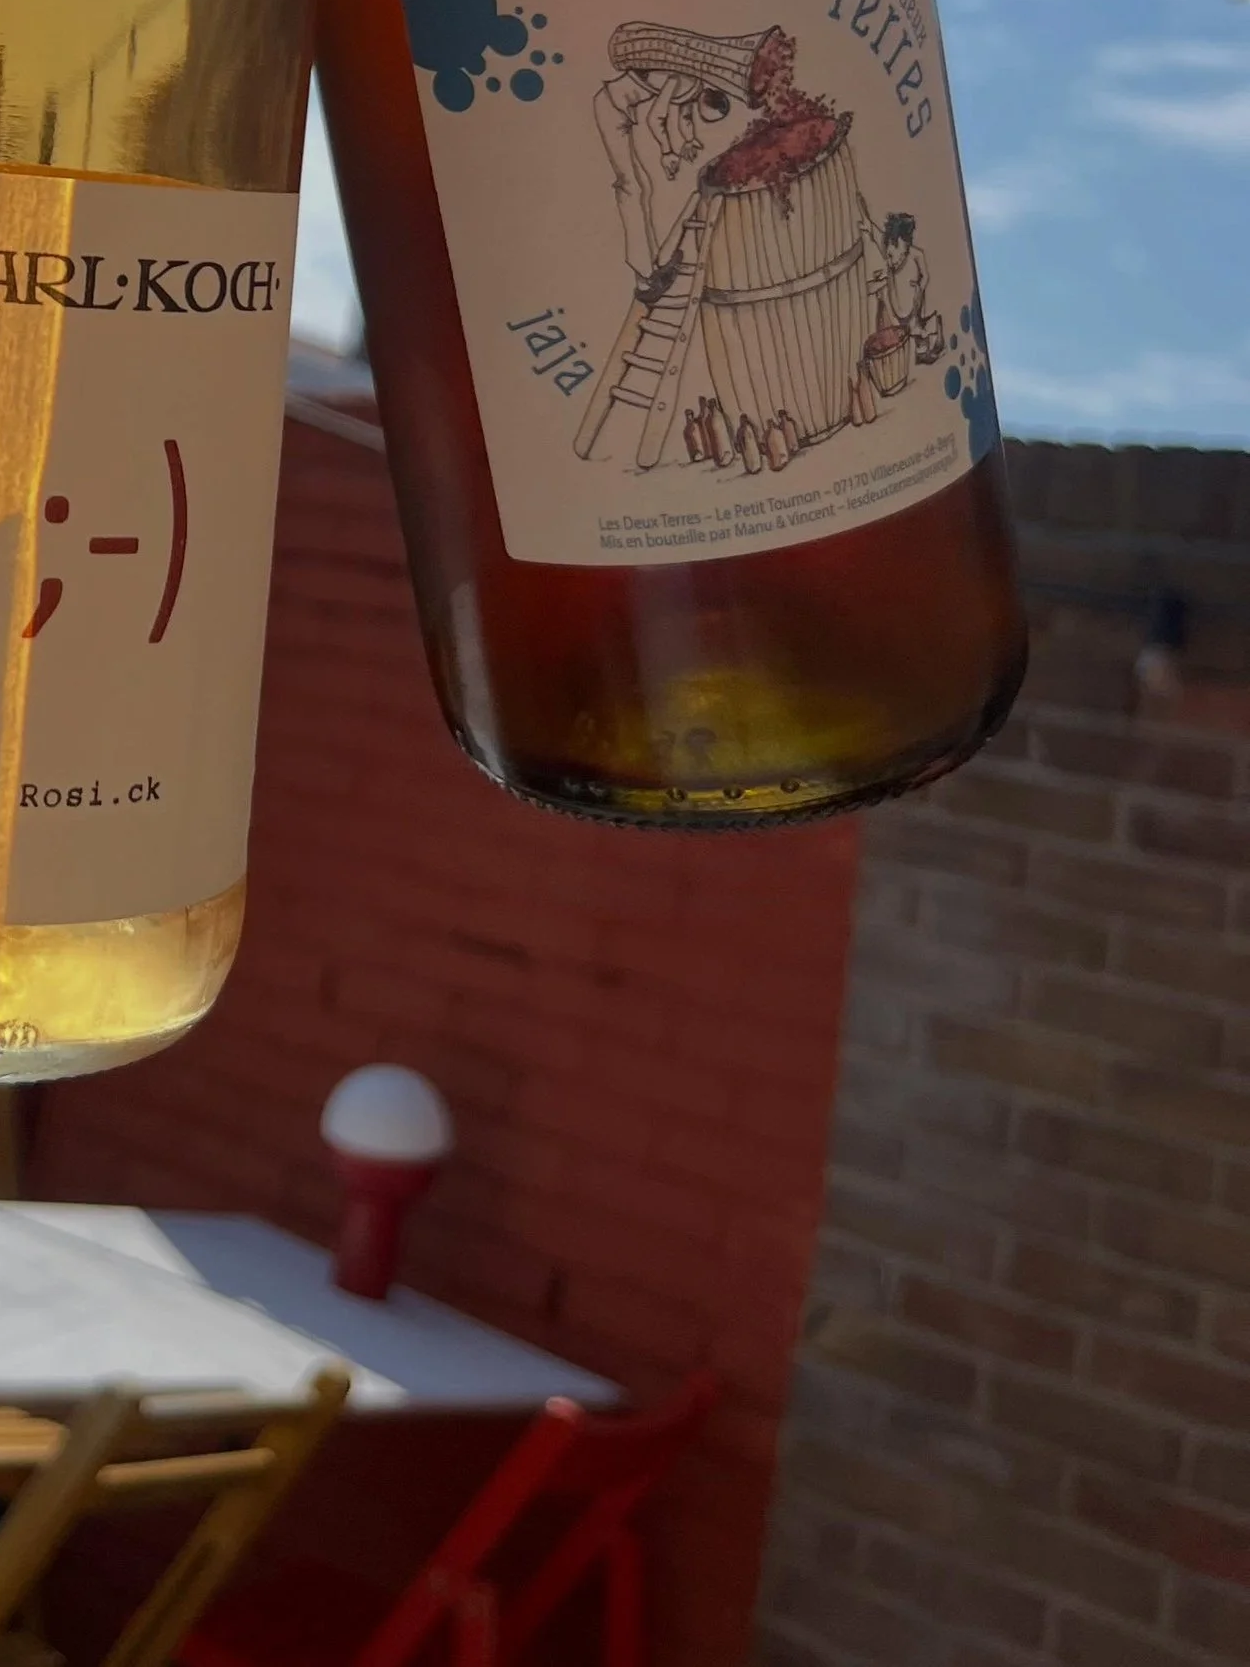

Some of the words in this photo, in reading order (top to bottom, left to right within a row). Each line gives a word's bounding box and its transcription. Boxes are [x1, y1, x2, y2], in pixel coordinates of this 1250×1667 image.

[506, 307, 595, 397] jaja
[599, 516, 620, 531] Les
[622, 515, 658, 531] Deux
[660, 513, 701, 528] Terres
[715, 507, 732, 522] Le
[733, 500, 766, 519] Petit
[833, 472, 869, 497] 07170
[600, 535, 624, 549] Mis
[626, 536, 644, 549] en
[646, 530, 706, 547] bouteille
[708, 528, 732, 544] par
[734, 519, 773, 538] Manu
[787, 504, 837, 526] Vincent
[19, 775, 161, 808] Rosi.ck
